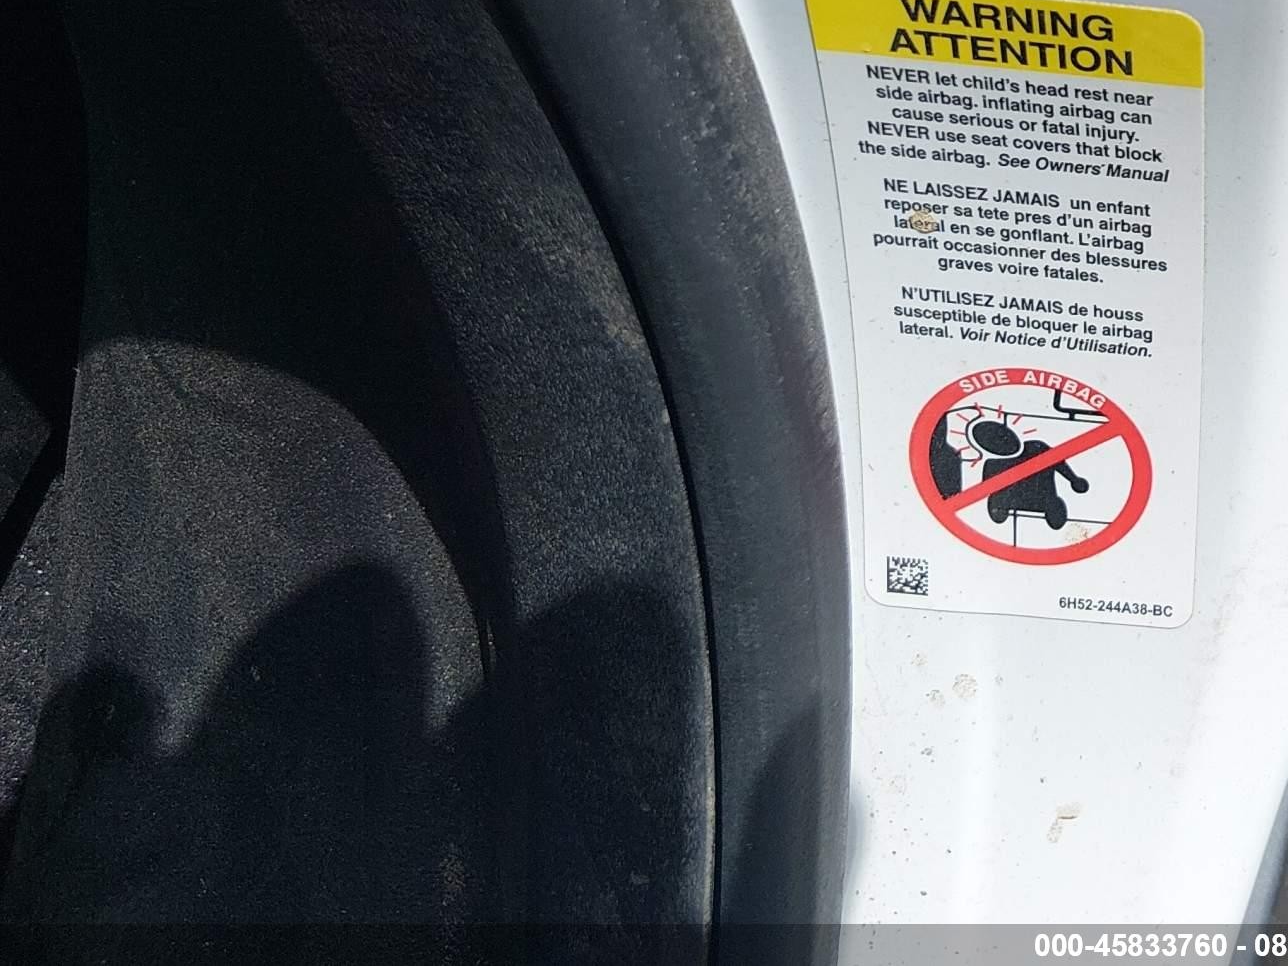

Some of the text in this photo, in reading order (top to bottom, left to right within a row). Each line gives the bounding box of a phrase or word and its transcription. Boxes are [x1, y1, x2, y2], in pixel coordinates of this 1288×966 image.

[889, 28, 1135, 77] ATTENTION
[866, 64, 1155, 108] NEVER let child's head rest near
[875, 85, 1153, 126] side airbag. inflating airbag can
[867, 120, 1163, 163] NEVER use seat covers that block
[891, 106, 1140, 145] cause serious or fatal injury.
[858, 139, 886, 155] the
[890, 142, 927, 160] side
[931, 148, 991, 170] airbag.
[997, 154, 1031, 170] See
[1106, 163, 1170, 183] Manual
[883, 177, 1152, 218] NE LAISSEZ JAMAIS un enfant
[884, 198, 1152, 238] reposer sa tete pres d'un airbag
[949, 222, 971, 235] en
[975, 224, 995, 238] se
[1000, 225, 1074, 245] gonflant.
[1078, 232, 1145, 254] L'airbag
[873, 232, 1168, 273] pourrait occasionner des blessures
[937, 256, 1104, 284] graves voire fatales.
[901, 285, 1144, 322] N'UTILISEZ JAMAIS de houss
[893, 304, 1153, 344] susceptible de bloquer le airbag
[899, 320, 1153, 358] lateral. Voir Notice d'Utilisation.
[958, 369, 1108, 410] SIDE AIRBAG
[1058, 596, 1174, 618] 6H52-244A38-BC
